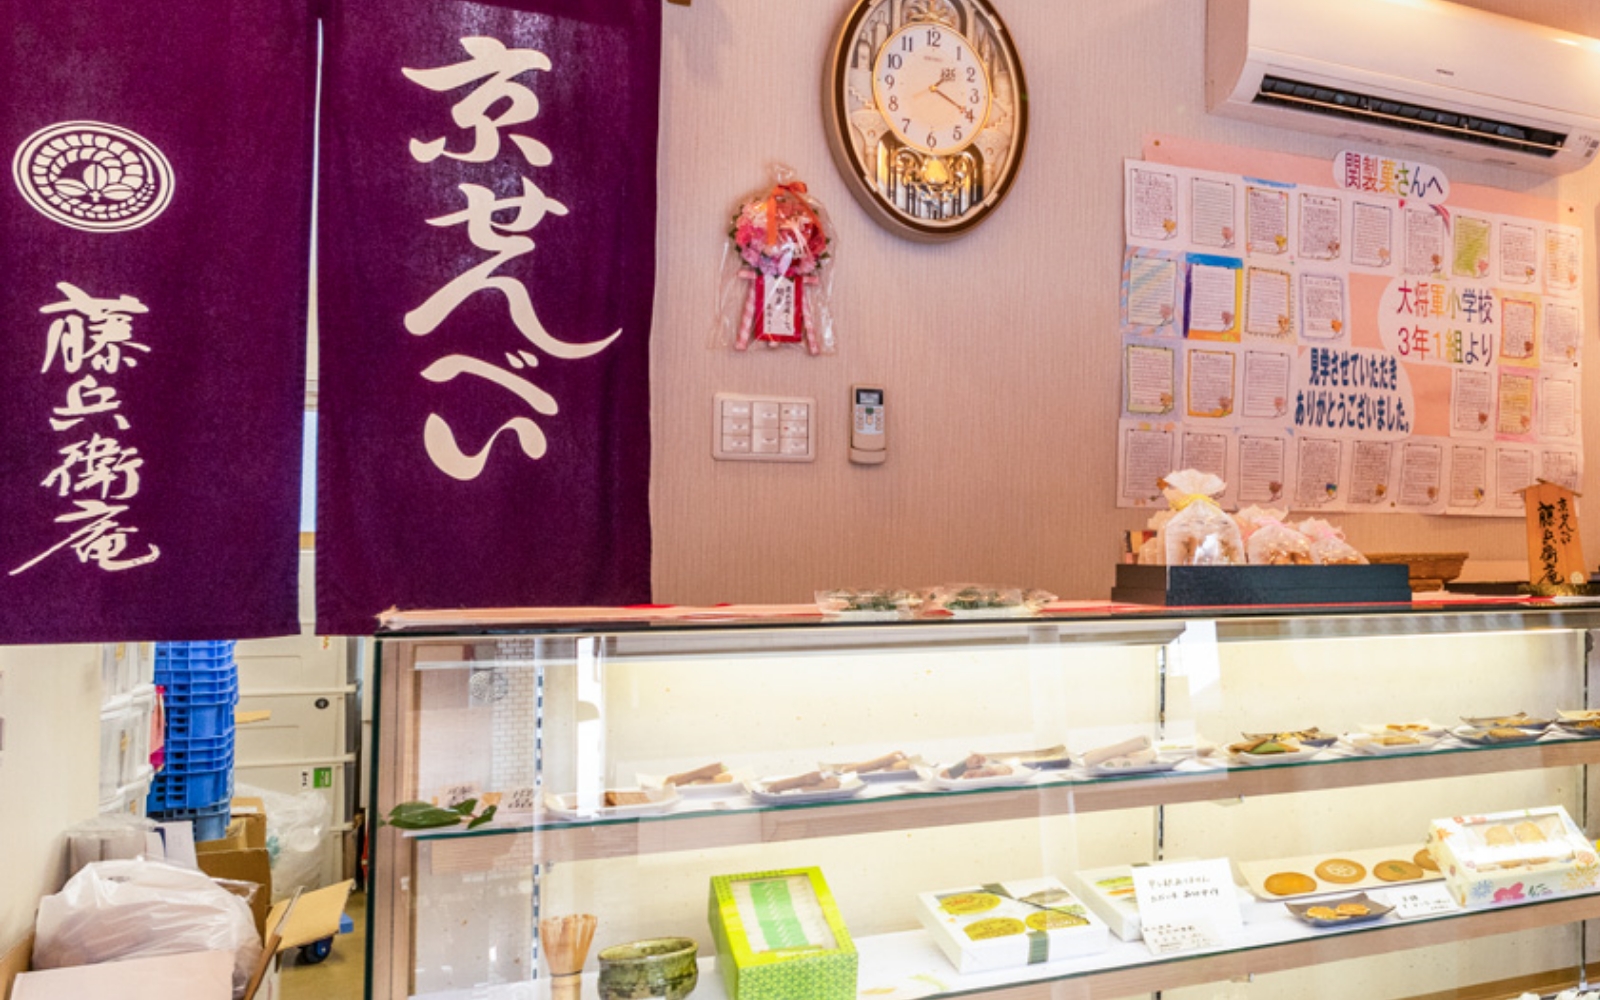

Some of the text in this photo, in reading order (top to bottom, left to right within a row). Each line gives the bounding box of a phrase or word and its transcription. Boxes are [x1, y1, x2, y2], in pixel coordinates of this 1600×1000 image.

[901, 36, 913, 52] 11
[926, 30, 941, 47] 12
[956, 46, 961, 60] 1
[887, 54, 902, 69] 10
[885, 75, 894, 90] 9
[966, 67, 975, 82] 2
[888, 96, 898, 112] 8
[970, 89, 979, 104] 3
[965, 109, 974, 123] 4
[902, 119, 910, 134] 7
[953, 126, 962, 141] 5
[927, 132, 936, 148] 6
[401, 36, 623, 481] 京せんべい
[1397, 281, 1494, 325] 大将軍小学校
[1398, 325, 1493, 366] 3年1組より
[1309, 348, 1398, 391] 見学させていただき
[9, 282, 160, 576] 藤兵衛庵
